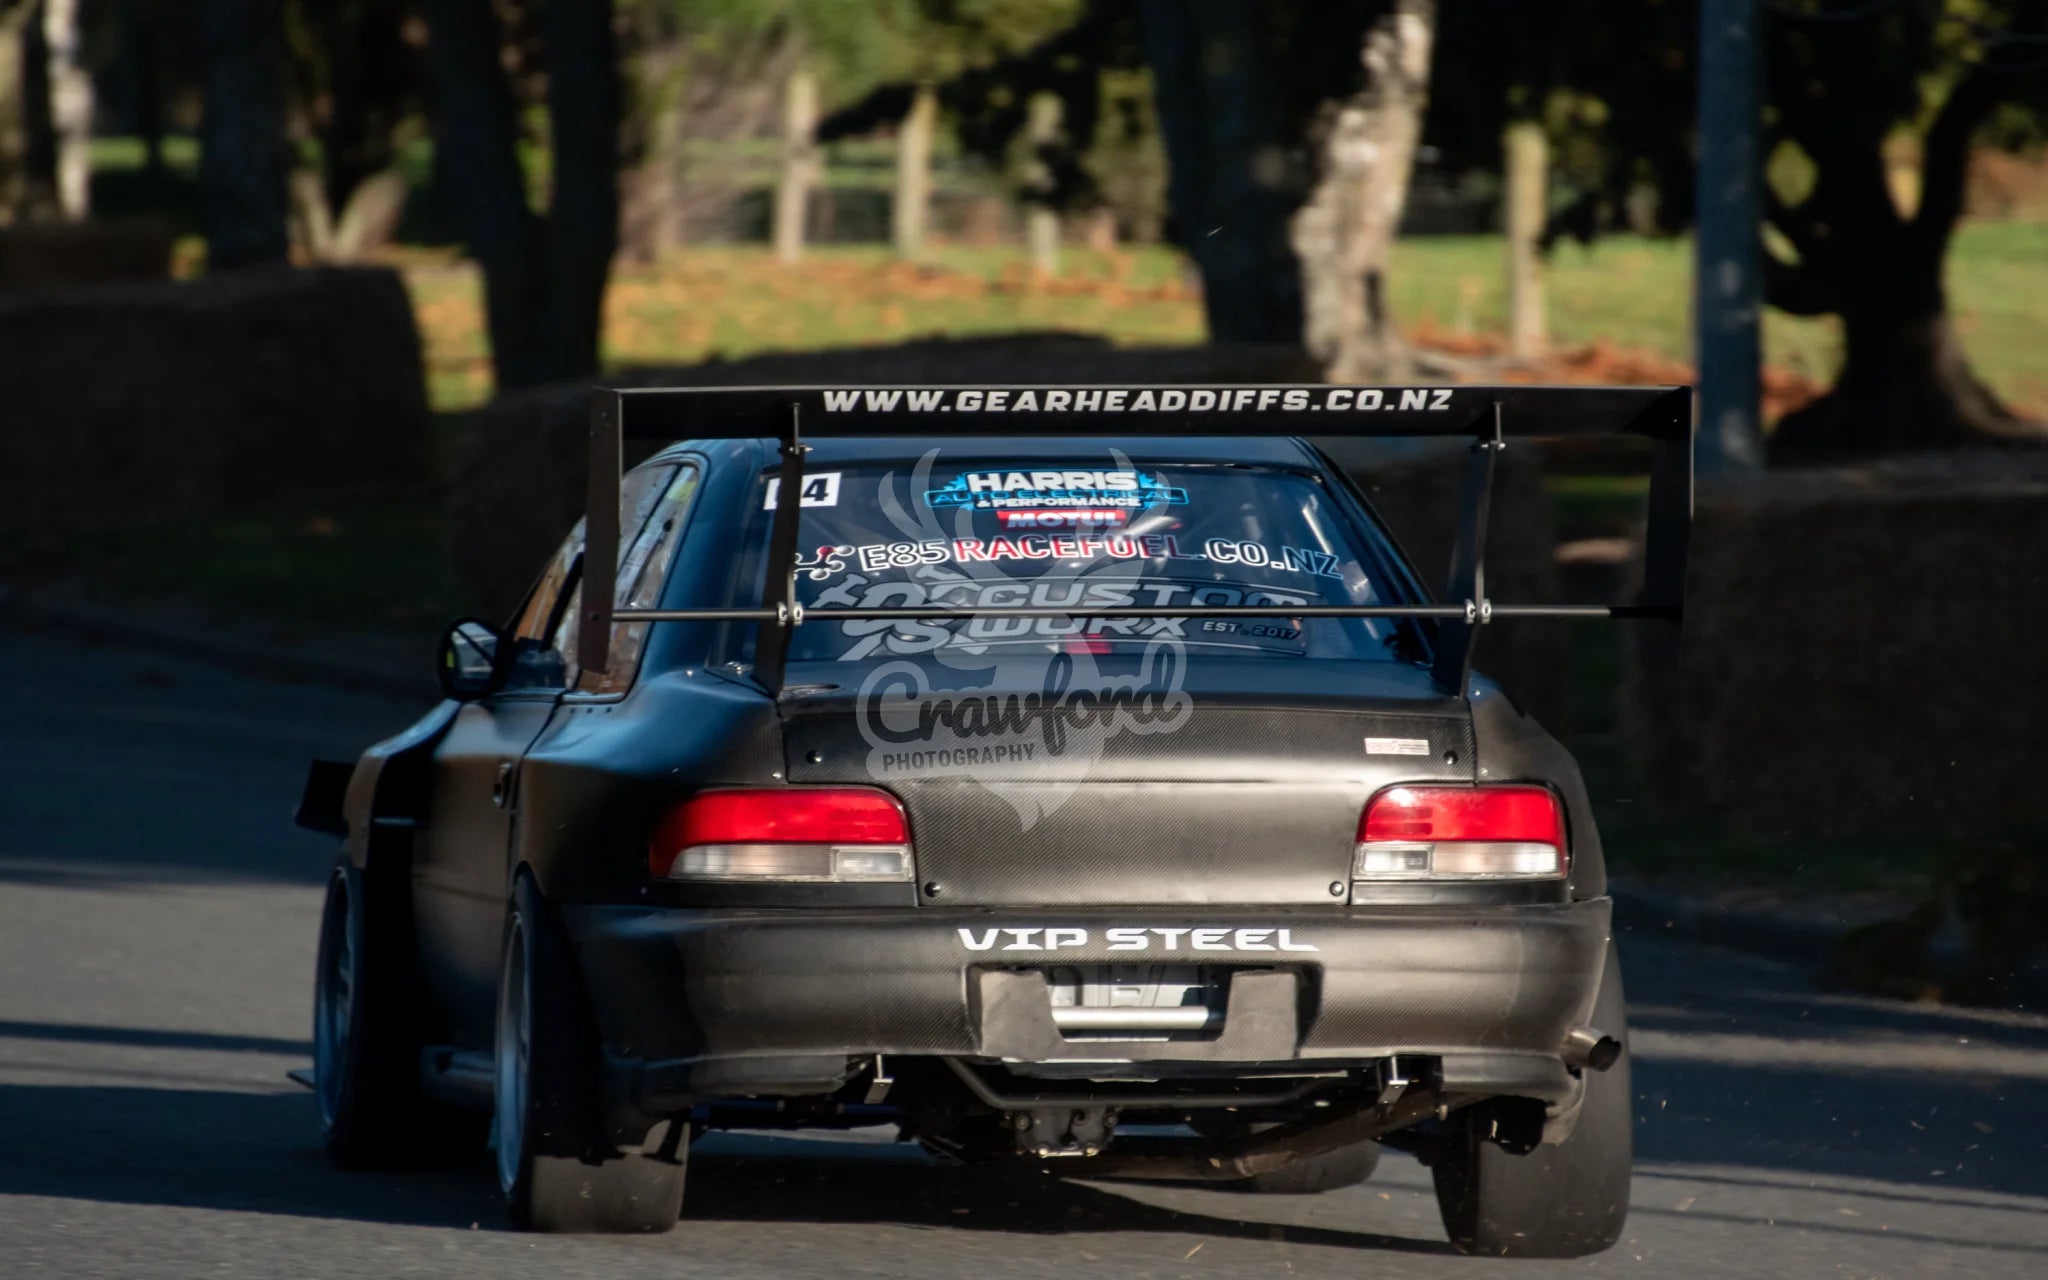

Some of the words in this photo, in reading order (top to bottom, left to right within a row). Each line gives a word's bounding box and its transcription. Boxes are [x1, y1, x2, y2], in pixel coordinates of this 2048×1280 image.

[823, 389, 1453, 412] WWW.GEARHEADDIFFS.CO.NZ
[967, 471, 1139, 492] HARRIS
[933, 490, 1009, 503] AUTO
[1015, 489, 1181, 501] ELECTRICAL
[994, 497, 1142, 508] PERFORMANCE
[1007, 512, 1122, 529] MOTUL
[1254, 625, 1301, 640] 2017
[957, 928, 1088, 950] VIP
[1105, 928, 1320, 951] STEEL
